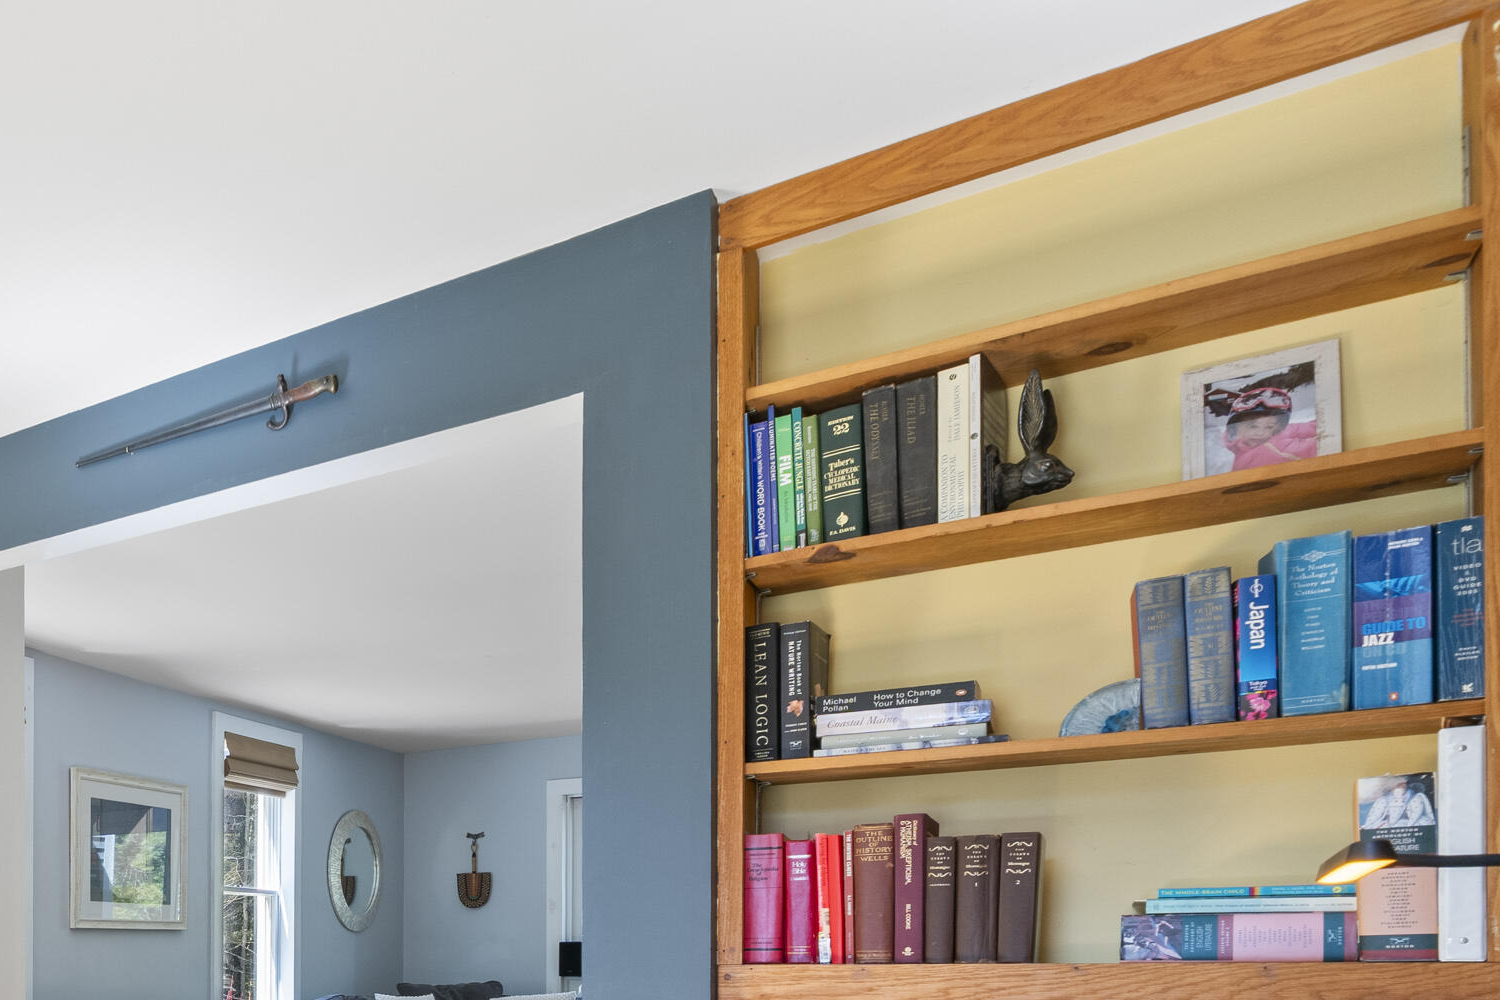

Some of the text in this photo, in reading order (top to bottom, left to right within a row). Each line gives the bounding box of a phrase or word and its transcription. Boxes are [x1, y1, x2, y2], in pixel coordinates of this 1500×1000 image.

[907, 395, 917, 444] THE ILIAD
[832, 422, 850, 436] 22
[869, 402, 881, 461] THE ODYSSEY
[768, 420, 776, 460] ILLUMINATED
[793, 421, 802, 462] CONCRETE
[778, 454, 792, 487] FILM
[794, 462, 804, 491] JUNGLE
[823, 465, 860, 480] CYCLOPEDIC
[824, 478, 860, 492] DICTIONARY
[828, 473, 856, 485] MEDICAL
[756, 480, 765, 505] WORD
[757, 506, 766, 531] BOOK
[839, 526, 856, 534] DAVIS
[1452, 537, 1483, 556] tla
[1307, 562, 1336, 571] Norton
[1453, 562, 1483, 570] VIDEO
[1289, 572, 1328, 580] Anthology
[1291, 577, 1335, 589] Theory and
[1294, 588, 1332, 596] Criticism
[1453, 582, 1483, 590] GUIDE
[1244, 601, 1269, 650] Japan
[1361, 616, 1427, 635] GUIDE TO
[1362, 632, 1395, 647] JAZZ
[788, 668, 796, 696] WRITING
[754, 642, 769, 746] LEAN LOGIC
[895, 691, 905, 699] to
[906, 688, 942, 699] Change
[822, 696, 857, 706] Michael
[822, 704, 849, 712] Pollan
[873, 697, 919, 708] Your Mind
[826, 715, 899, 729] Coastal Maine
[856, 835, 893, 843] OUTLINE
[856, 846, 893, 854] HISTORY
